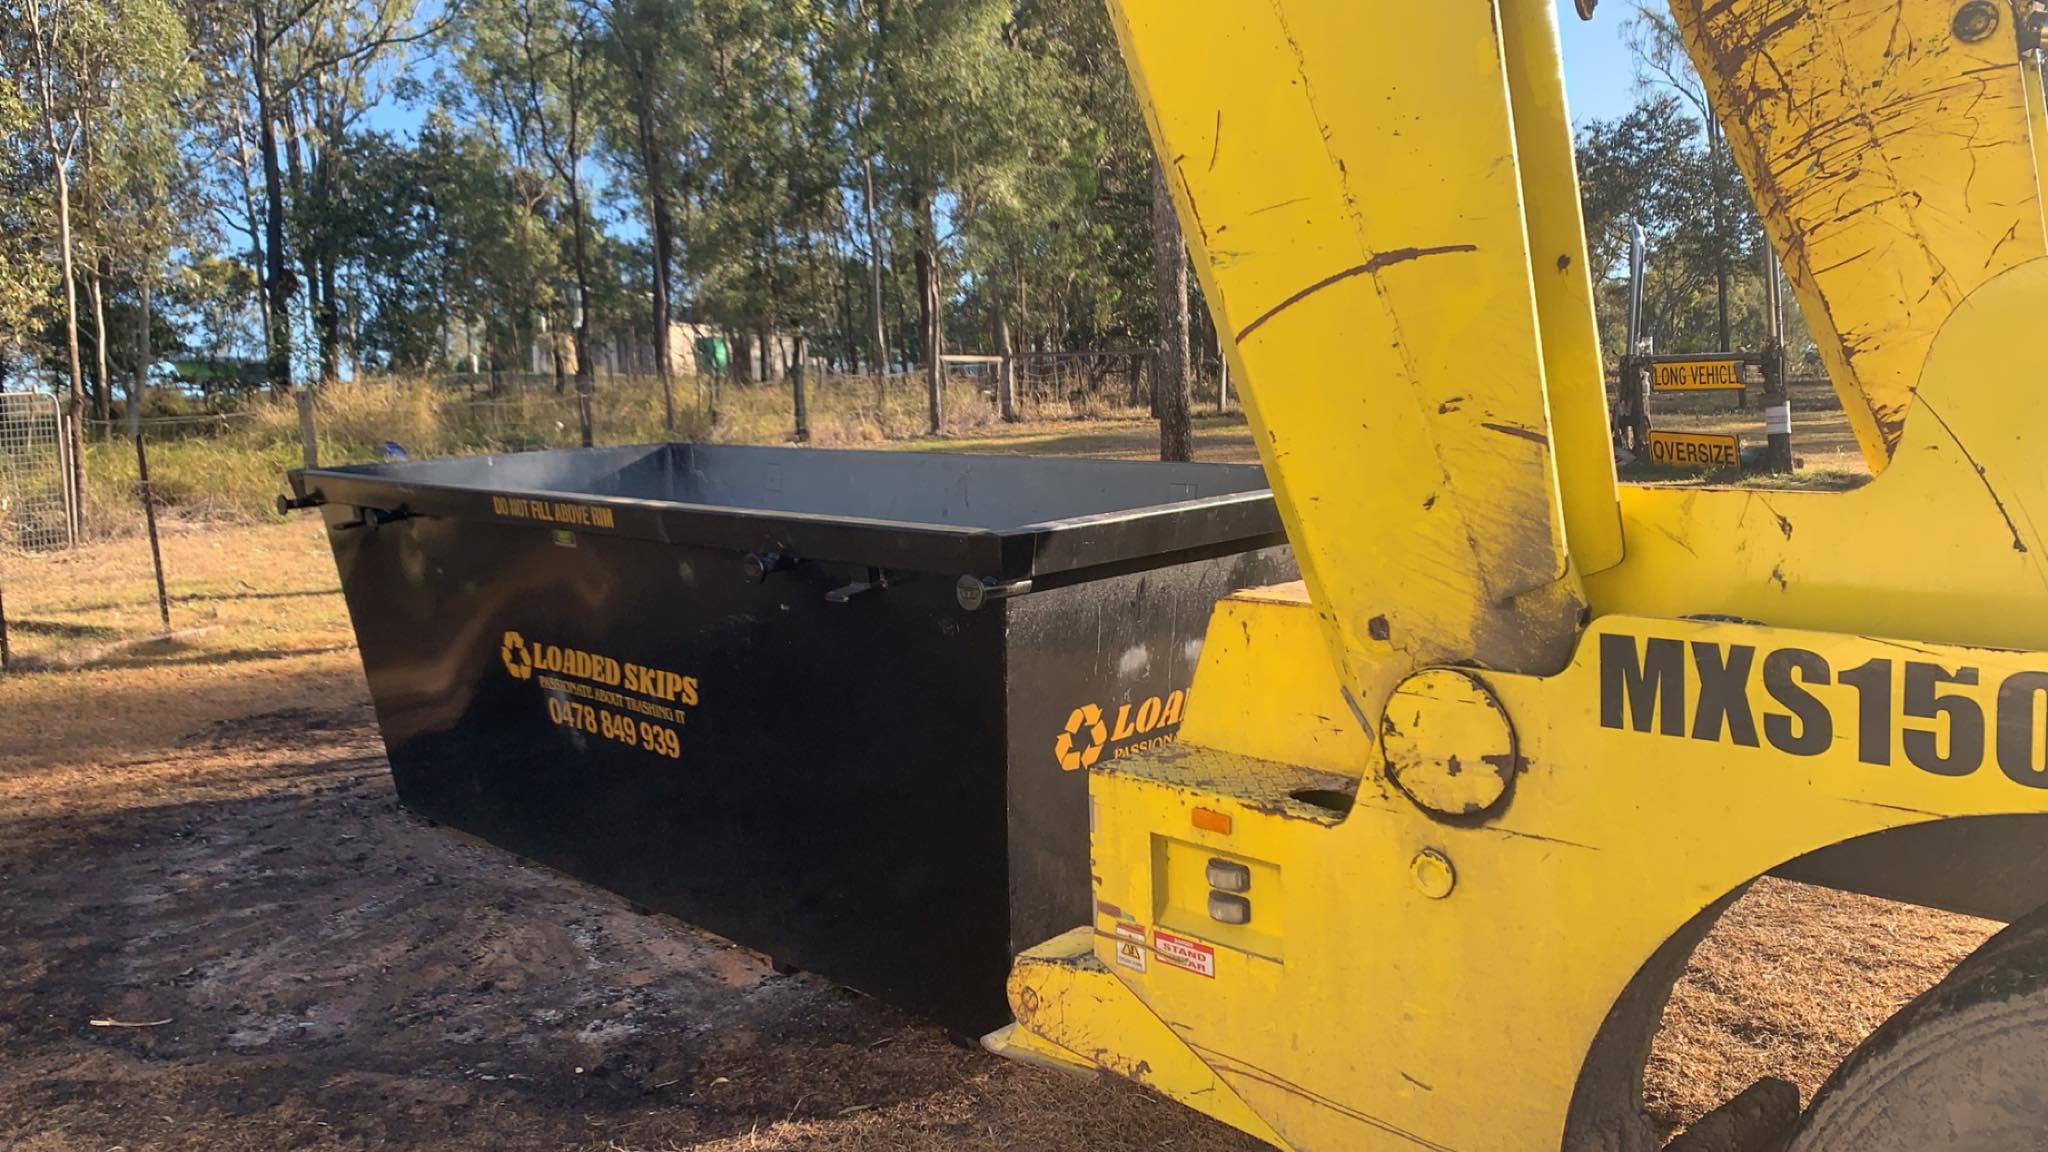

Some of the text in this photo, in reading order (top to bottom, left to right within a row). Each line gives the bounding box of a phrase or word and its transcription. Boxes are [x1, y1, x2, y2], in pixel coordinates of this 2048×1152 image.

[1654, 366, 1687, 386] LONG
[1653, 440, 1735, 465] OVERSIZE
[493, 496, 614, 528] DO NOT FILL ABOVE RIM
[533, 642, 699, 706] LOADED SKIPS
[538, 675, 686, 725] PASSIONATE ABOUT TRASHING IT
[1110, 687, 1190, 741] LOA
[1600, 632, 2048, 790] MXS150
[549, 697, 680, 759] 0478 849 939
[1114, 733, 1178, 759] PASSION
[1163, 942, 1206, 962] STAND
